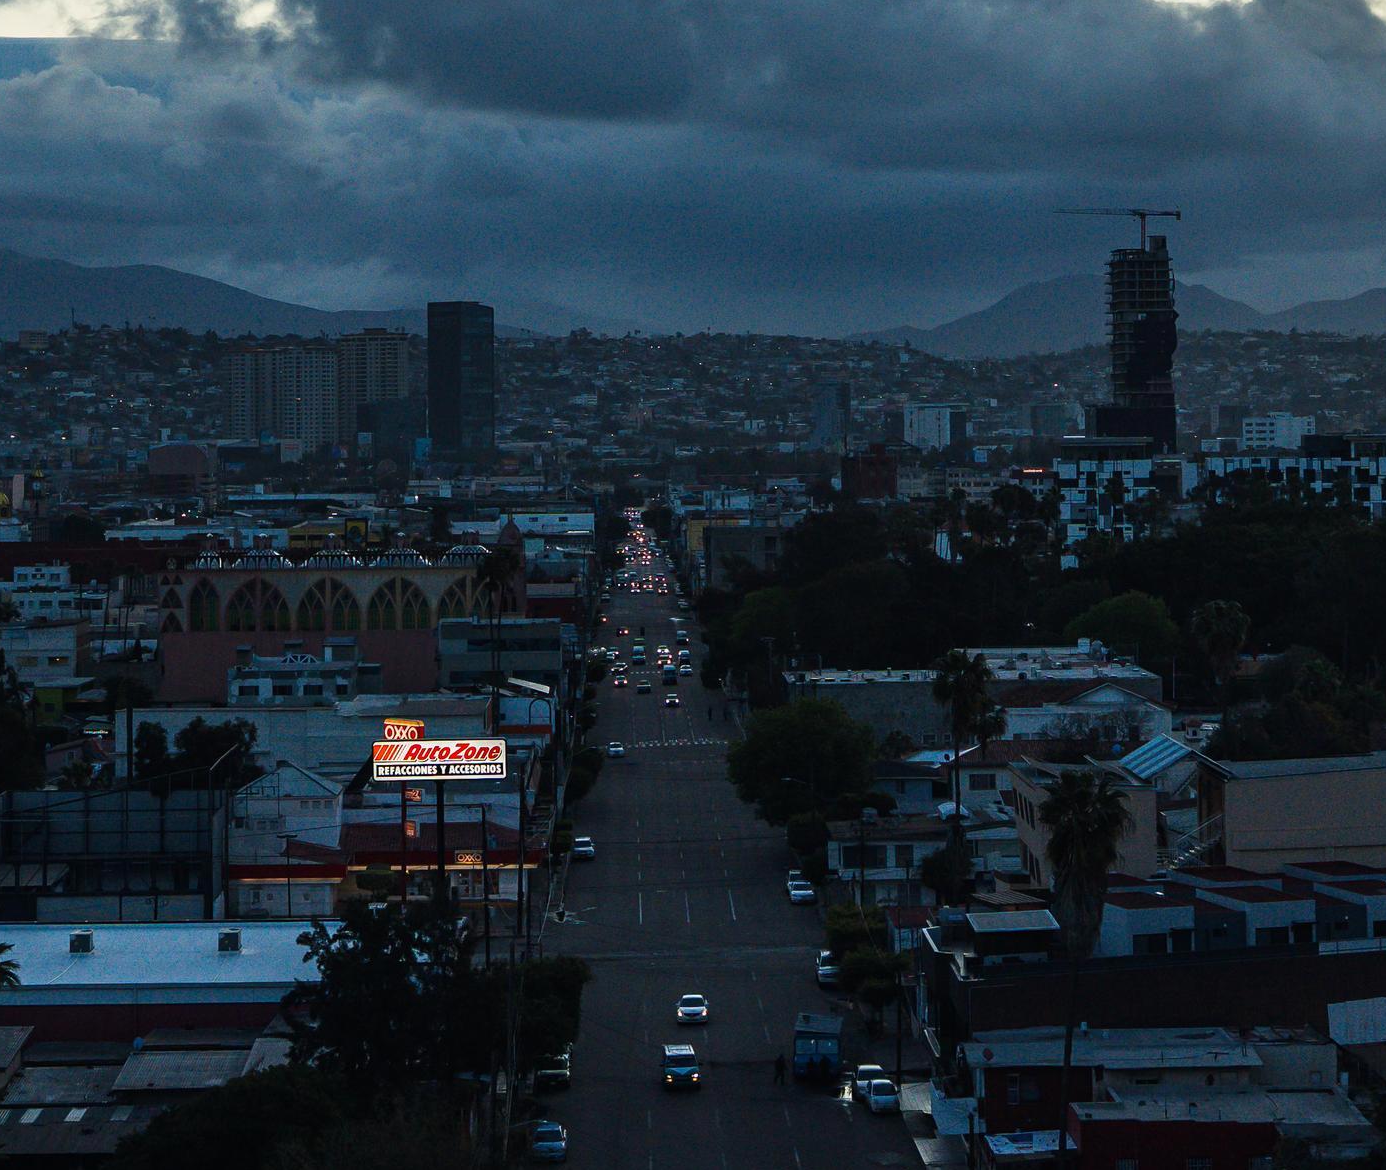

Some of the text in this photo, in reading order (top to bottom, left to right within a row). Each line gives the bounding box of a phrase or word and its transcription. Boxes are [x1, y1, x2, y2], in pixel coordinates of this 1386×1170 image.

[384, 725, 418, 740] OXXO
[403, 743, 502, 762] AutoZone
[378, 764, 502, 776] REFACCIONES Y ACCESORIOS
[457, 853, 482, 862] OXXO
